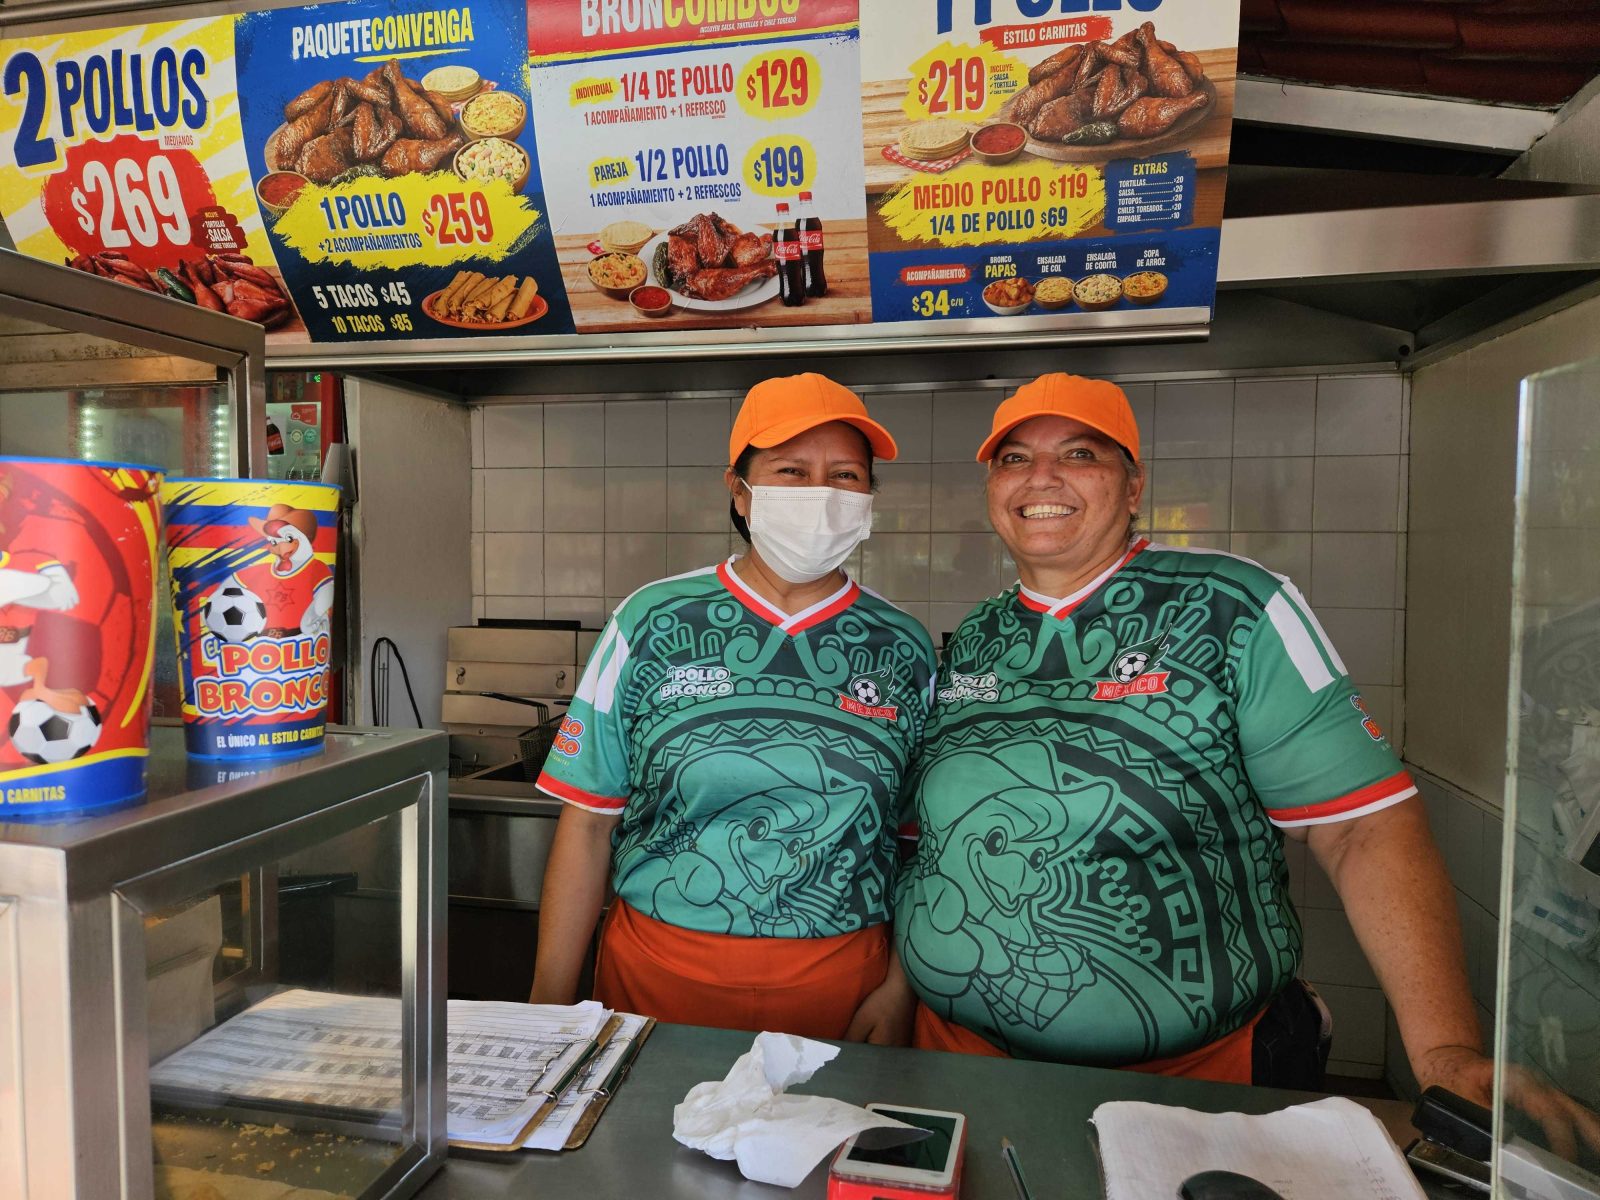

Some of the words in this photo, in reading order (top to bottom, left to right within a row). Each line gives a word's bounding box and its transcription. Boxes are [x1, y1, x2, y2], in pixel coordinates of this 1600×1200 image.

[1003, 29, 1035, 45] ESTILO
[1039, 23, 1087, 41] CARNITAS
[575, 82, 613, 100] INDIVIDUAL
[621, 72, 649, 102] 1/4
[655, 69, 676, 99] DE
[682, 63, 734, 97] POLLO
[746, 57, 809, 108] $129
[918, 56, 985, 114] $219
[993, 73, 1009, 81] SALSA
[994, 80, 1018, 88] TORTILLAS
[4, 52, 57, 167] 2
[56, 47, 207, 137] POLLOS
[584, 112, 589, 126] 1
[591, 105, 667, 125] ACOMPAÑAMIENTO
[678, 103, 683, 118] 1
[685, 100, 726, 117] REFRESCO
[164, 134, 194, 146] MEDIANOS
[594, 161, 629, 182] PAREJA
[635, 149, 668, 182] 1/2
[672, 143, 729, 179] POLLO
[753, 145, 804, 187] $199
[1133, 162, 1168, 176] EXTRAS
[590, 193, 595, 207] 1
[596, 187, 675, 207] ACOMPAÑAMIENTO
[686, 186, 693, 200] 2
[694, 183, 742, 199] REFRESCOS
[913, 181, 973, 210] MEDIO
[981, 176, 1041, 205] POLLO
[1049, 173, 1088, 199] $119
[71, 155, 191, 248] $269
[335, 192, 407, 229] POLLO
[1117, 206, 1135, 214] CHILES
[422, 191, 494, 245] $259
[929, 214, 955, 236] 1/4
[961, 213, 980, 233] DE
[986, 208, 1035, 232] POLLO
[1040, 206, 1068, 227] $69
[207, 227, 234, 242] SALSA
[333, 233, 422, 252] ACOMPAÑAMIENTOS
[989, 255, 1012, 264] BRONCO
[1037, 256, 1066, 265] ENSALADA
[1086, 252, 1116, 261] ENSALADA
[1136, 259, 1144, 267] DE
[1145, 258, 1166, 267] ARROZ
[1143, 249, 1159, 258] SOPA
[906, 268, 966, 281] ACOMPAÑAMIENTOS
[985, 263, 1017, 278] PAPAS
[1041, 265, 1049, 273] DE
[1050, 264, 1061, 272] COL
[1085, 262, 1093, 270] DE
[312, 285, 329, 309] 5
[326, 283, 378, 308] TACOS
[381, 281, 412, 306] $45
[912, 289, 950, 317] $34
[950, 297, 964, 306] C/U
[331, 316, 347, 333] 10
[347, 315, 386, 333] TACOS
[390, 313, 413, 332] $85
[221, 635, 329, 675] POLLO
[674, 667, 729, 683] POLLO
[952, 673, 997, 689] POLLO
[661, 682, 733, 699] BRONCO
[939, 685, 998, 701] BRONCO
[1101, 676, 1159, 698] MEXICO
[846, 699, 893, 718] MEXICO
[216, 735, 227, 748] EL
[228, 733, 256, 748] ÚNICO
[258, 733, 270, 746] AL
[271, 730, 299, 745] ESTILO
[7, 785, 66, 804] CARNITAS
